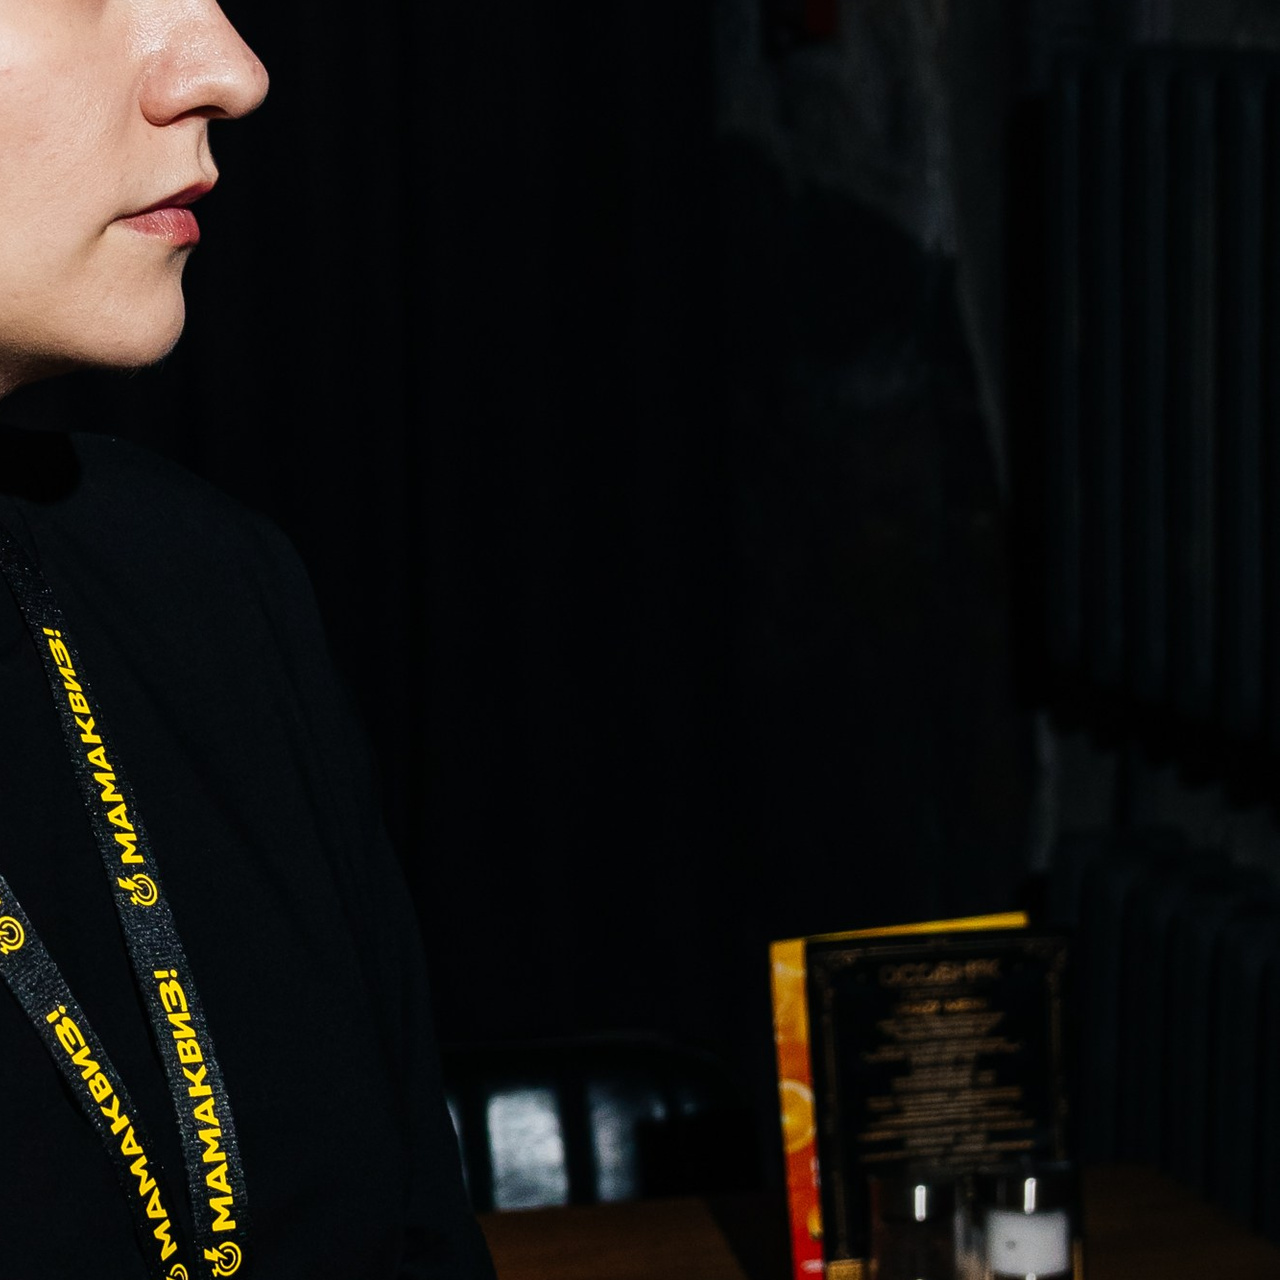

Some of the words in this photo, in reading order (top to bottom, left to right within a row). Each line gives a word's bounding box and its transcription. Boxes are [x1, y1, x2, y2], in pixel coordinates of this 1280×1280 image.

[39, 626, 145, 864] МАМАКВИЗ!
[46, 1005, 178, 1262] МАМАКВИЗ!
[153, 969, 237, 1232] МАМАКВИЗ!
